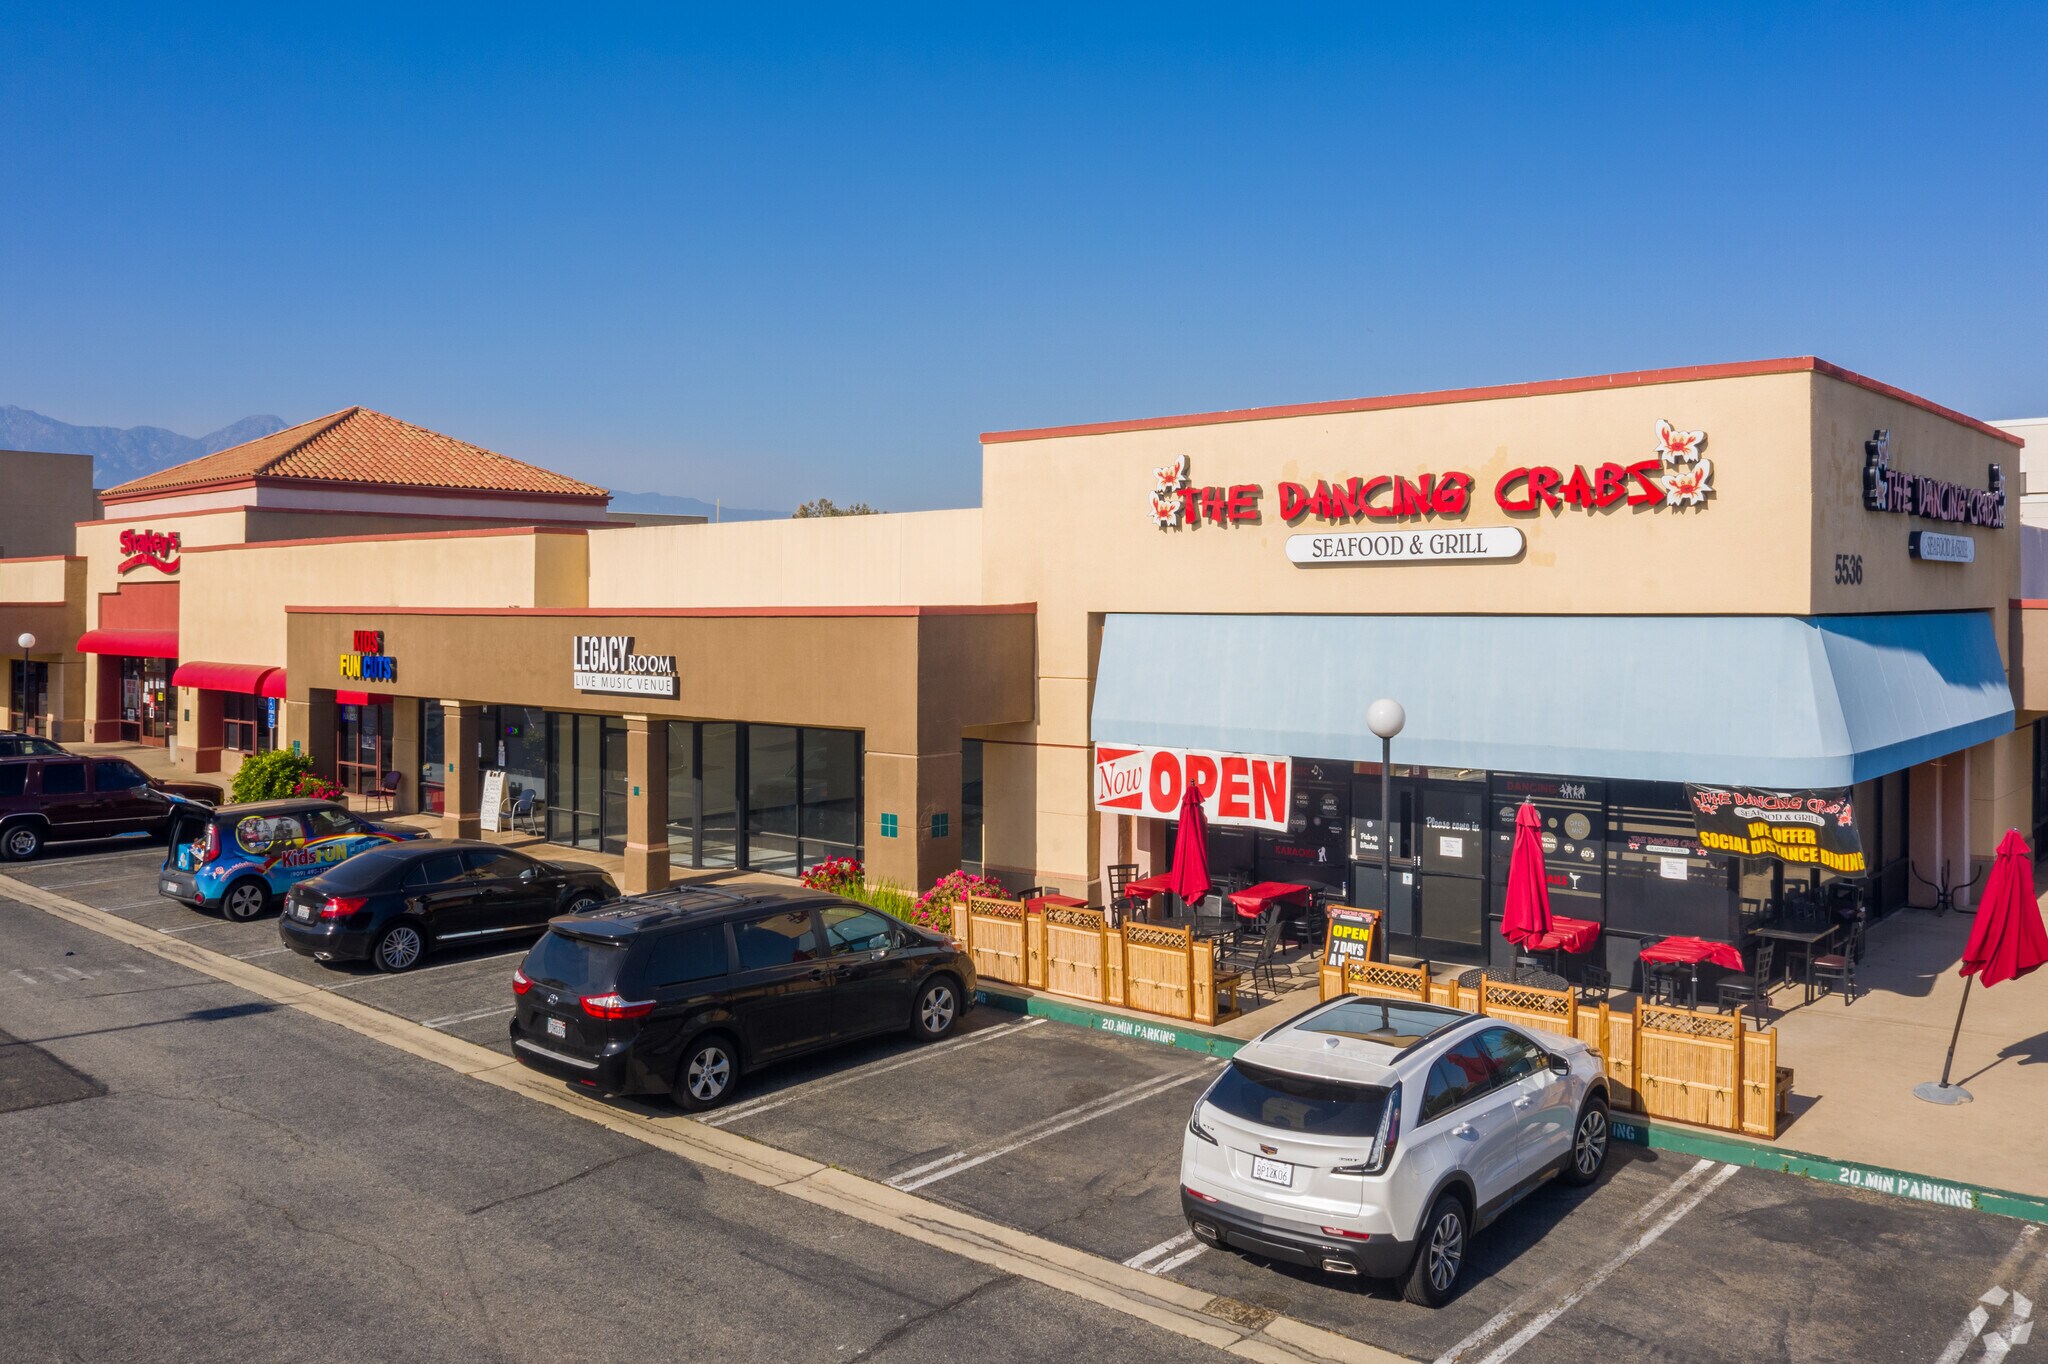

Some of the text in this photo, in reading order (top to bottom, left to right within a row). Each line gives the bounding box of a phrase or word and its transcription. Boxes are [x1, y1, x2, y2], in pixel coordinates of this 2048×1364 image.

[1177, 459, 1667, 524] THE DANCING CRABS
[1886, 469, 2000, 527] THE DANCING CRABS
[1312, 533, 1488, 558] SEAFOOD & GRILL
[1835, 554, 1863, 585] 5536
[354, 630, 379, 653] KIDS
[574, 636, 671, 673] LEGACY ROOM
[340, 654, 392, 679] FUN CUTS
[576, 675, 671, 691] LIVE MUSIC VENUE
[1099, 750, 1287, 823] Now OPEN
[1506, 781, 1557, 793] DANCING
[1696, 791, 1732, 806] THE
[1733, 793, 1803, 810] DANCING
[1426, 816, 1451, 829] Please
[1452, 822, 1471, 831] come
[1740, 809, 1783, 821] SEAFOOD
[1794, 814, 1821, 824] GRILL
[1747, 821, 1817, 845] WE OFFER
[1274, 845, 1317, 859] KARAOKE
[1580, 850, 1595, 858] 60's
[1699, 831, 1866, 872] SOCIAL DISTANCE DINING
[1333, 924, 1370, 941] OPEN
[1333, 940, 1365, 956] 7 DAYS
[1329, 953, 1335, 966] A
[1134, 1025, 1176, 1043] PARKING
[1898, 1178, 1972, 1209] PARKING
